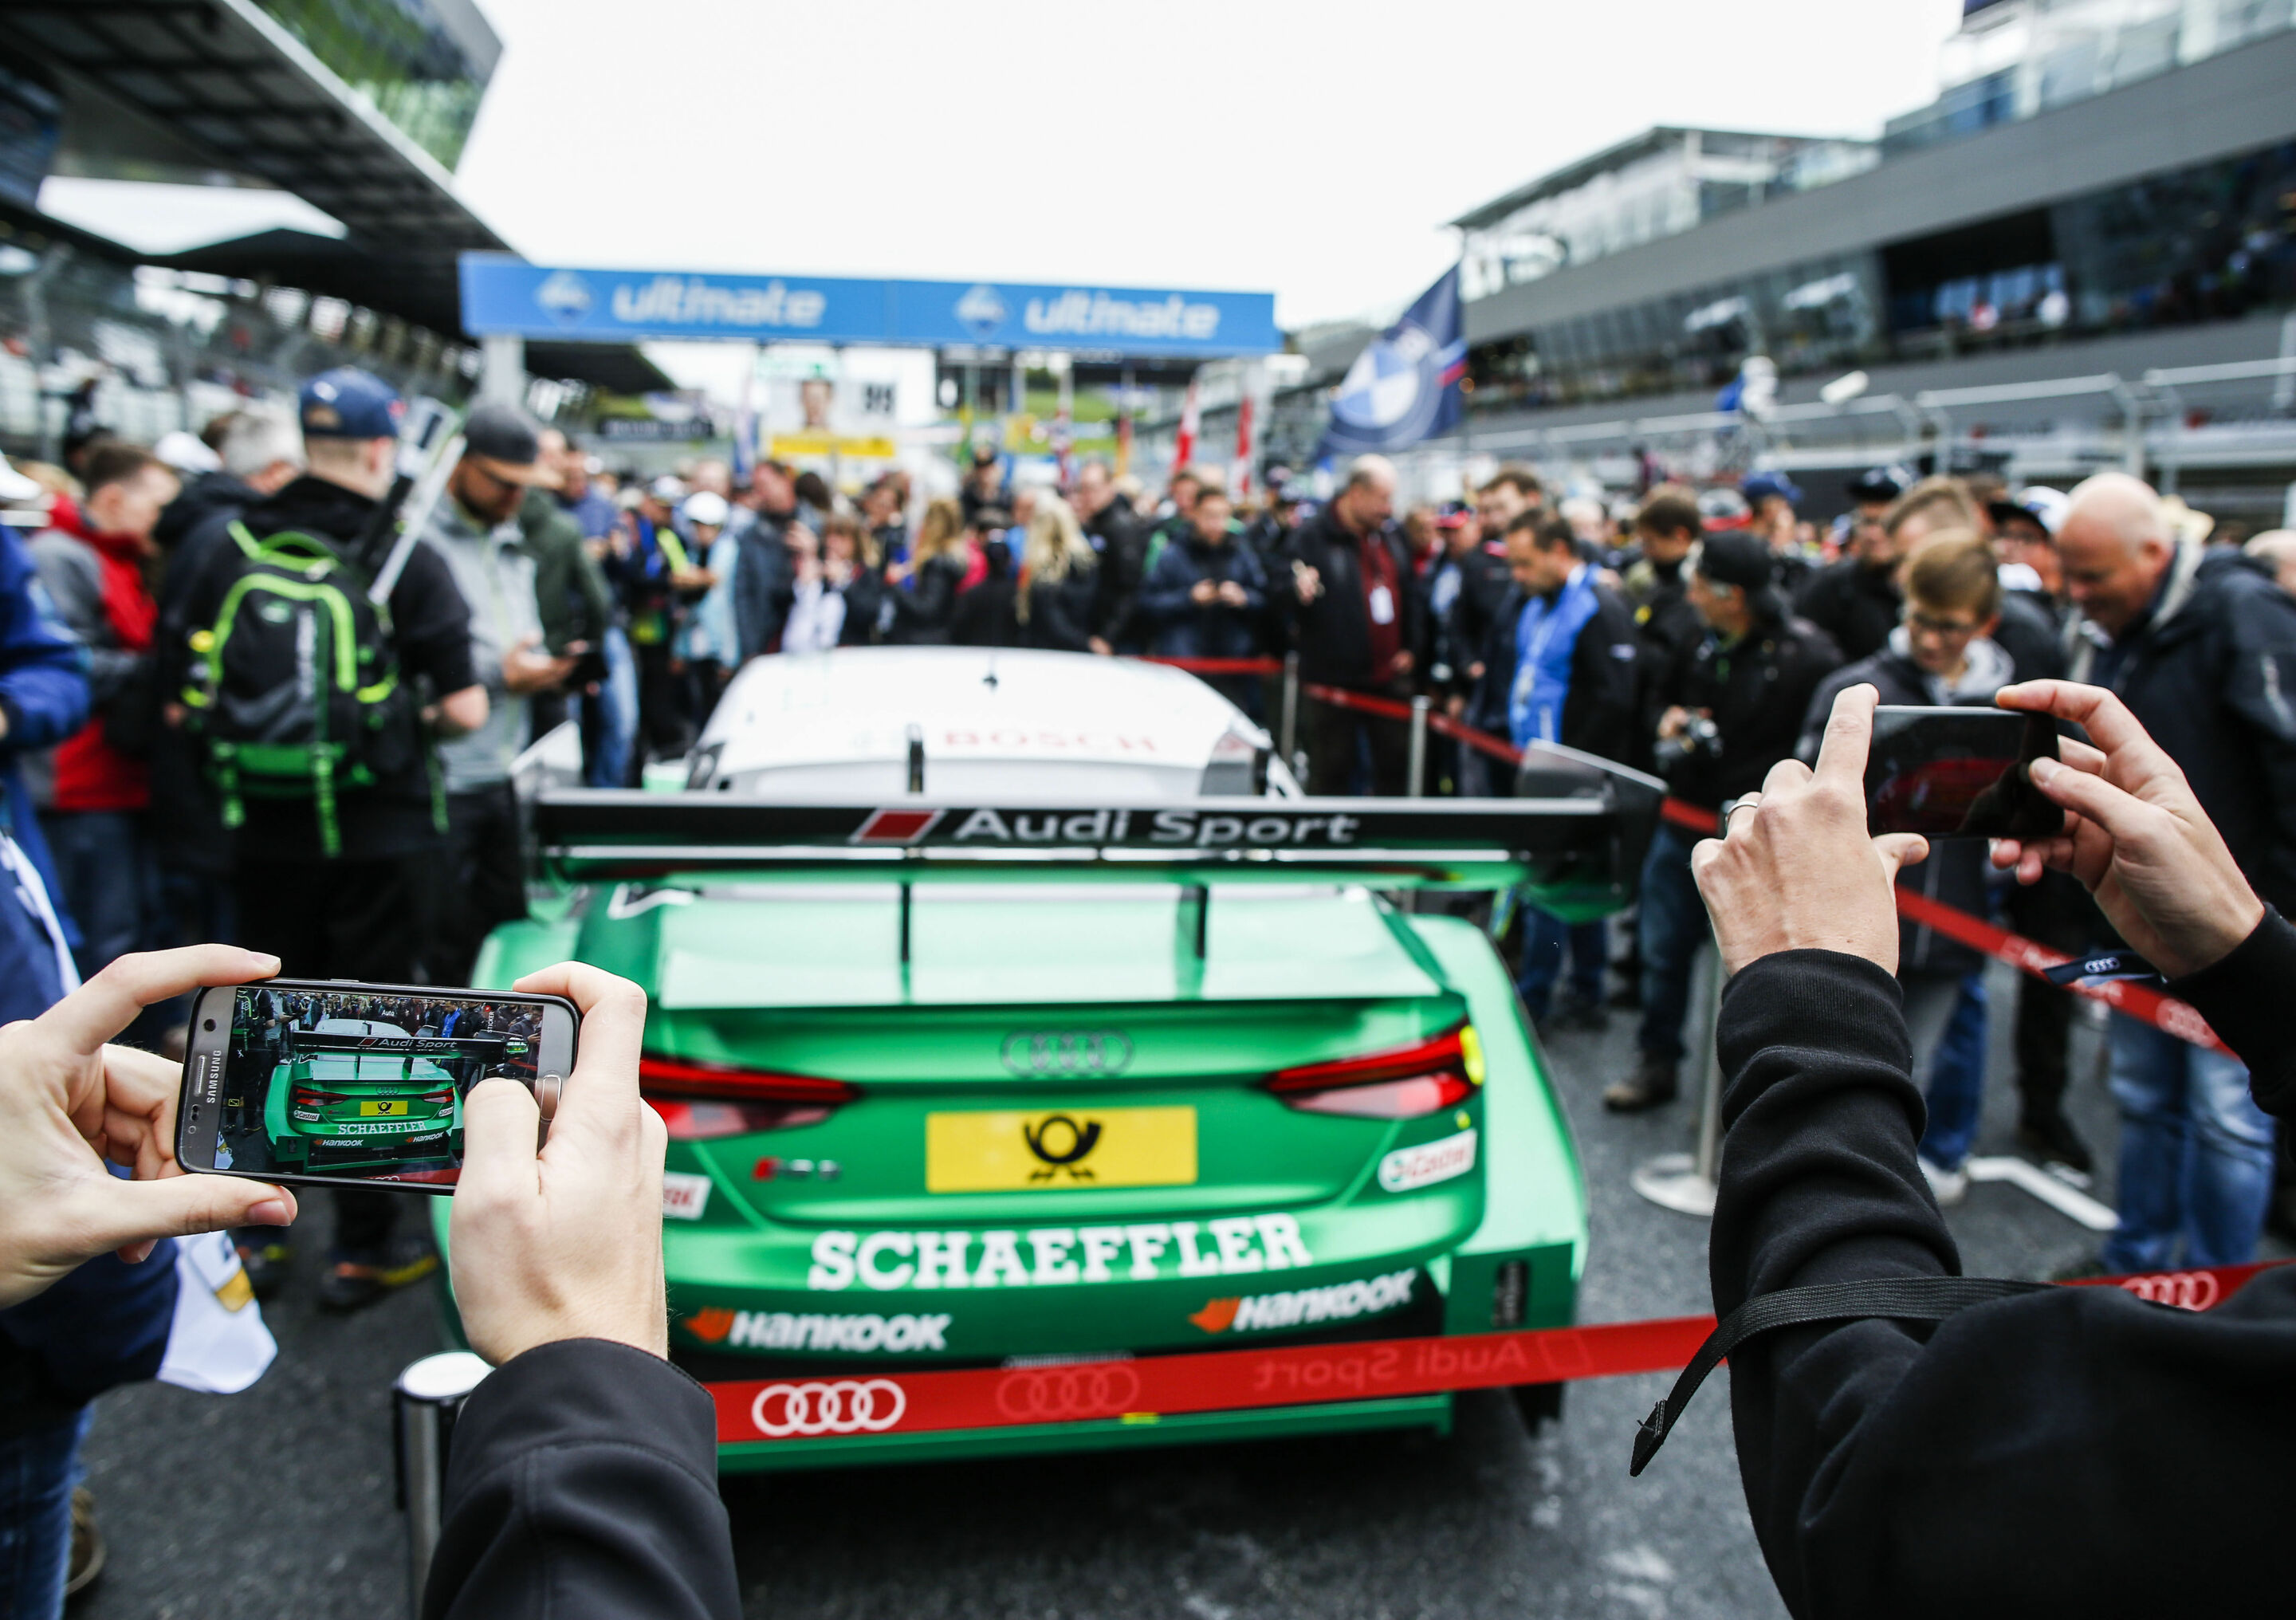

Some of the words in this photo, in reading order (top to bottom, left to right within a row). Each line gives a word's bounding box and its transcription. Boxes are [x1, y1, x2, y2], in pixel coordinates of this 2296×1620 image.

[612, 275, 825, 328] ultimate
[1024, 289, 1220, 340] ultimate
[945, 729, 1158, 753] BOSCH
[953, 808, 1130, 843] Audi
[1149, 809, 1360, 847] Sport
[378, 1038, 414, 1047] Audi
[415, 1039, 458, 1049] Sport
[206, 1049, 222, 1103] SAMSUNG
[299, 1111, 318, 1121] Castrol
[338, 1121, 427, 1135] SCHAEFFLER
[807, 1213, 1312, 1292] SCHAEFFLER
